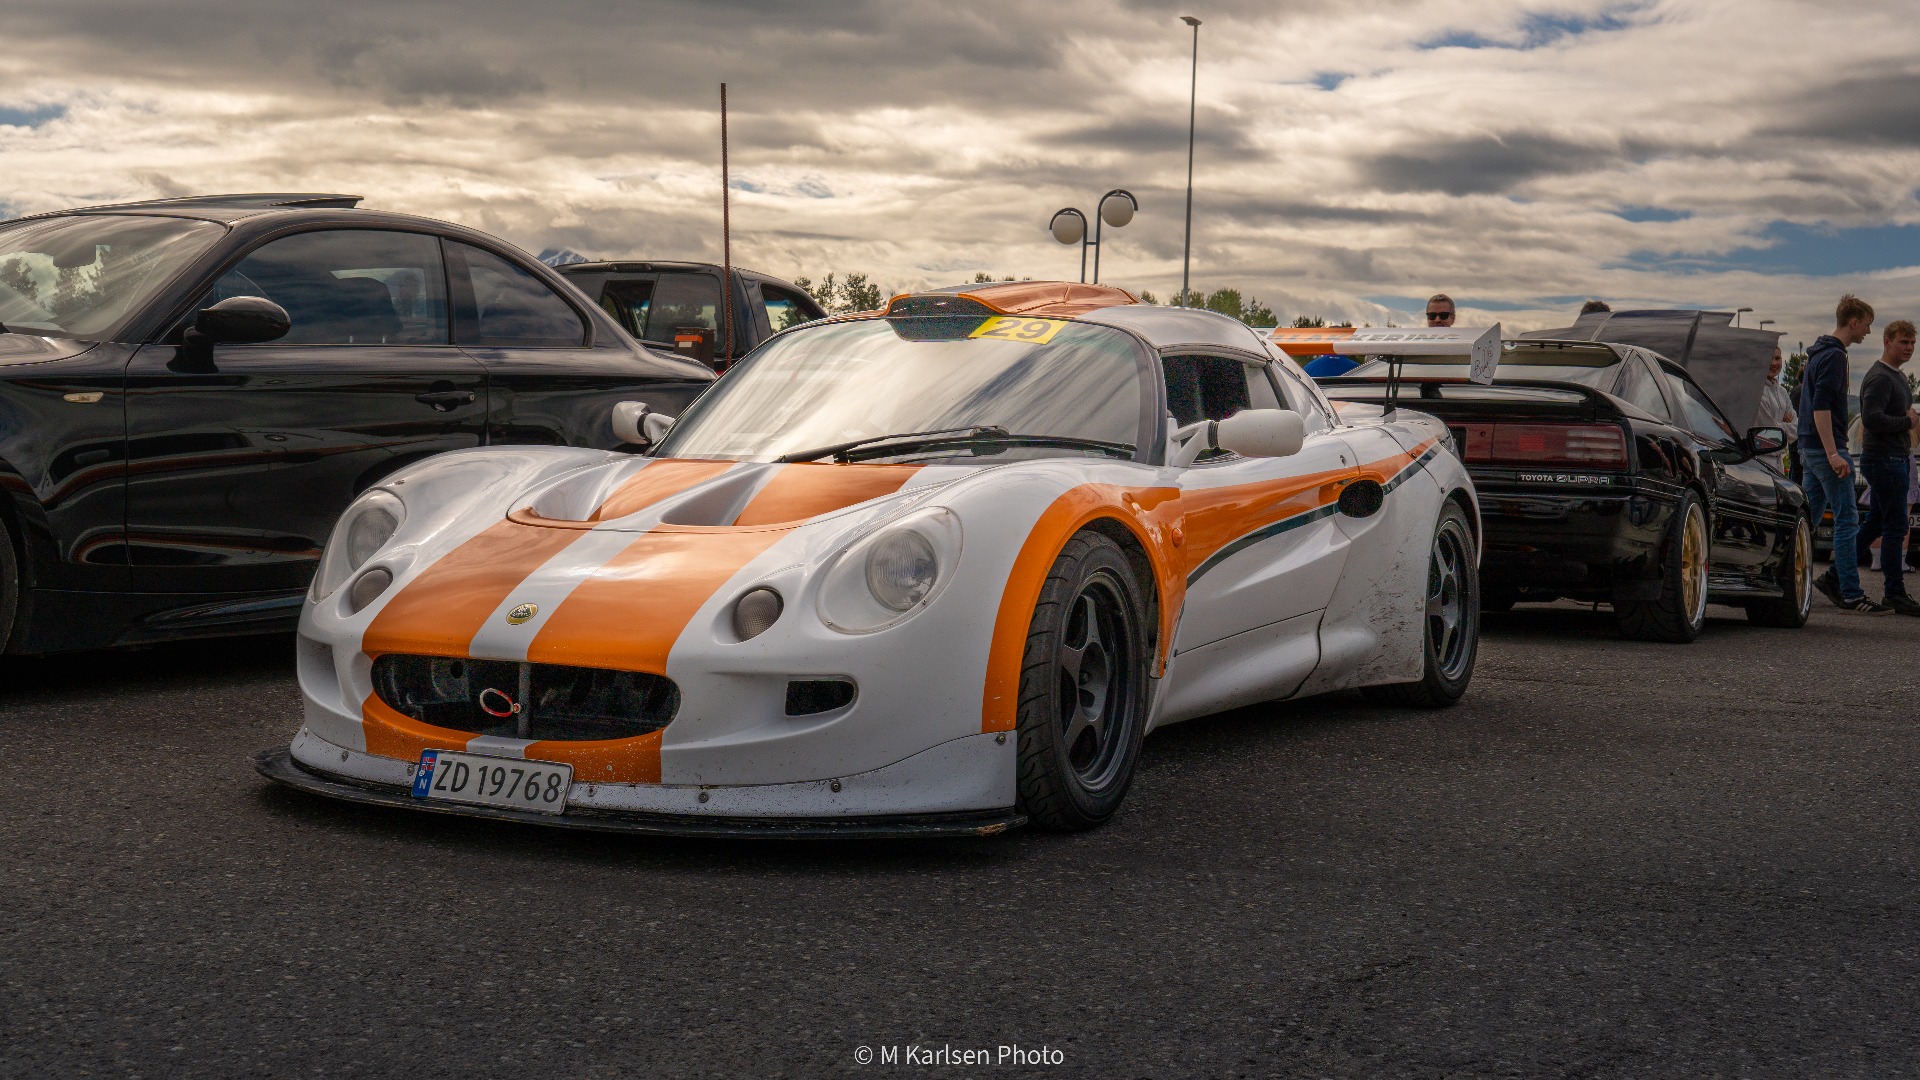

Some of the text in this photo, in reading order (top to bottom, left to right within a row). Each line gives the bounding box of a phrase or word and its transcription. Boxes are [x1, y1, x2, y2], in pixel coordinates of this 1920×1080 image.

[982, 319, 1052, 340] 29
[1520, 474, 1610, 485] TOYOTA SUPRA
[477, 765, 562, 803] 19768
